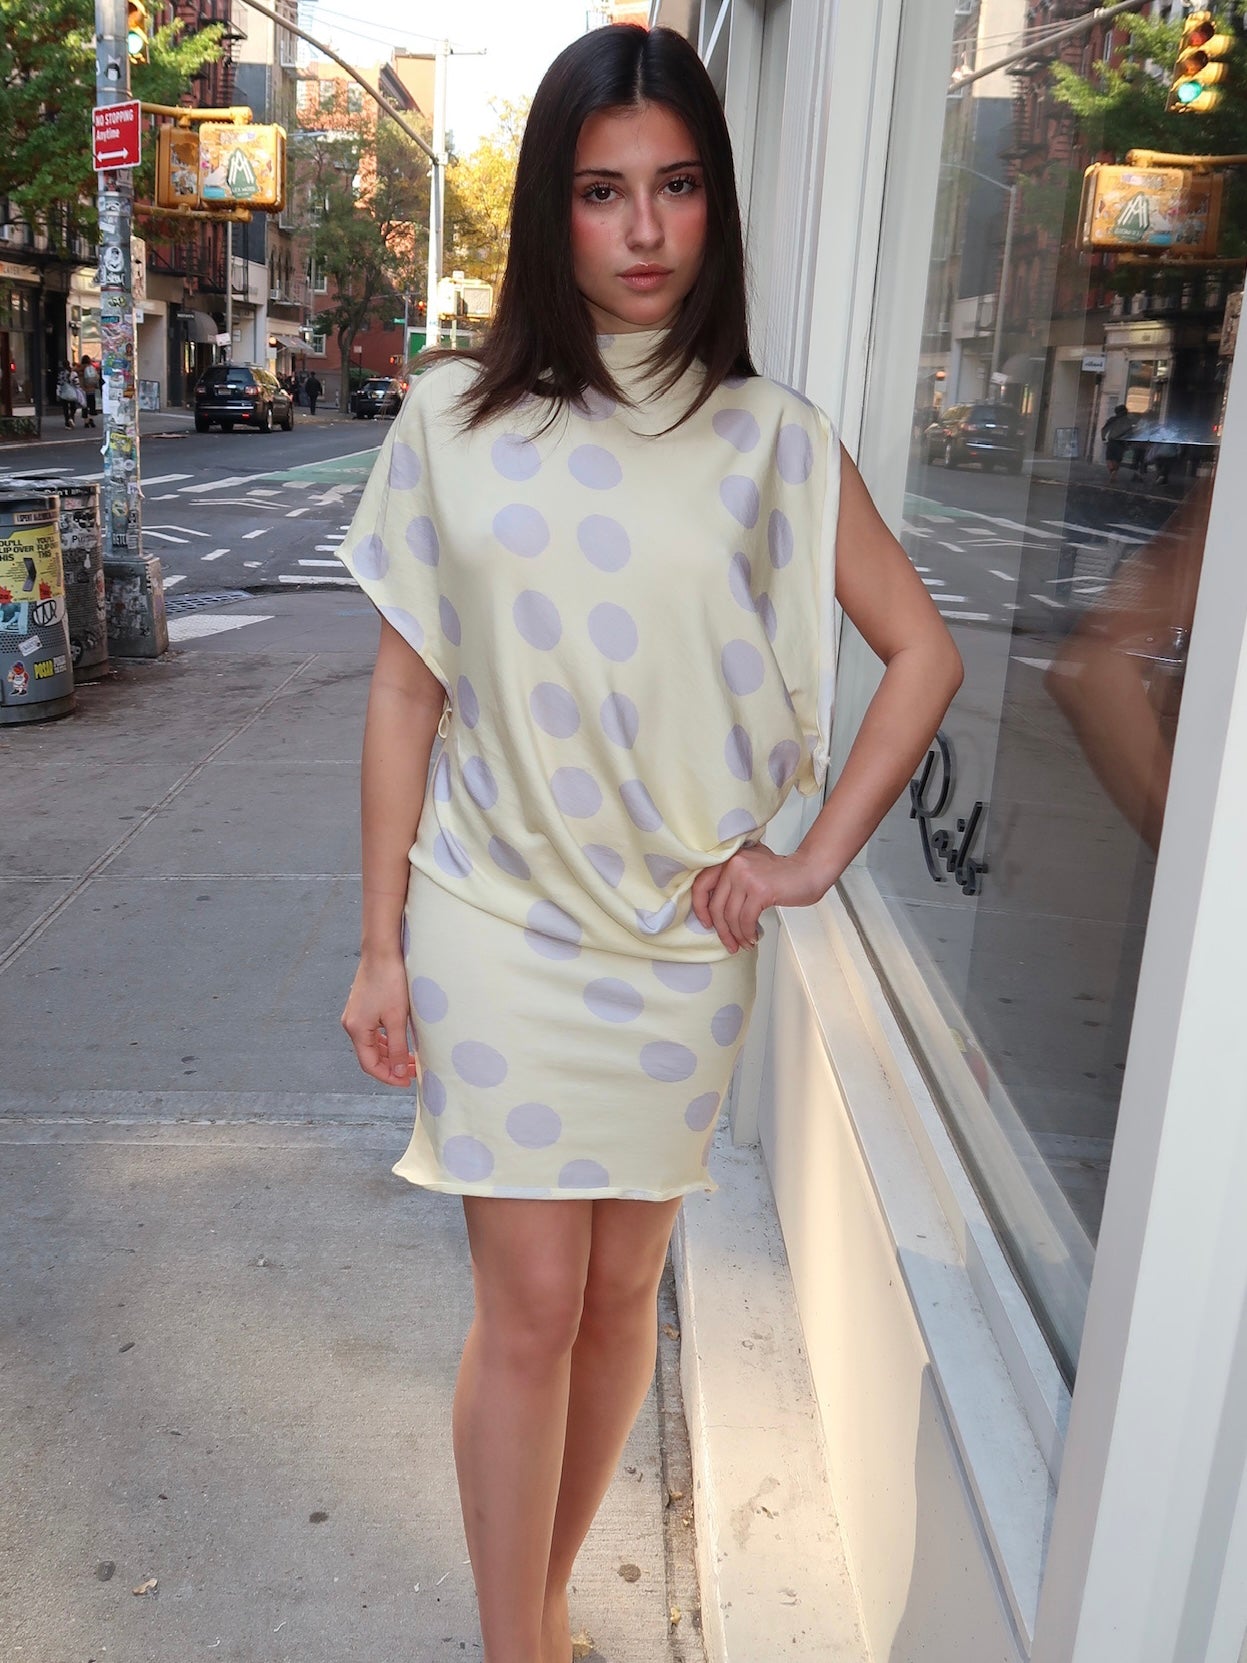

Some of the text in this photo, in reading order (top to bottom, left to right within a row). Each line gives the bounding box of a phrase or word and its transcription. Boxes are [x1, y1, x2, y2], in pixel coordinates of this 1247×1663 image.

[95, 109, 134, 126] NO STOPPING
[96, 127, 120, 142] Anytime
[0, 539, 23, 547] OU'LL
[13, 545, 34, 553] OVER
[0, 553, 15, 562] HIS
